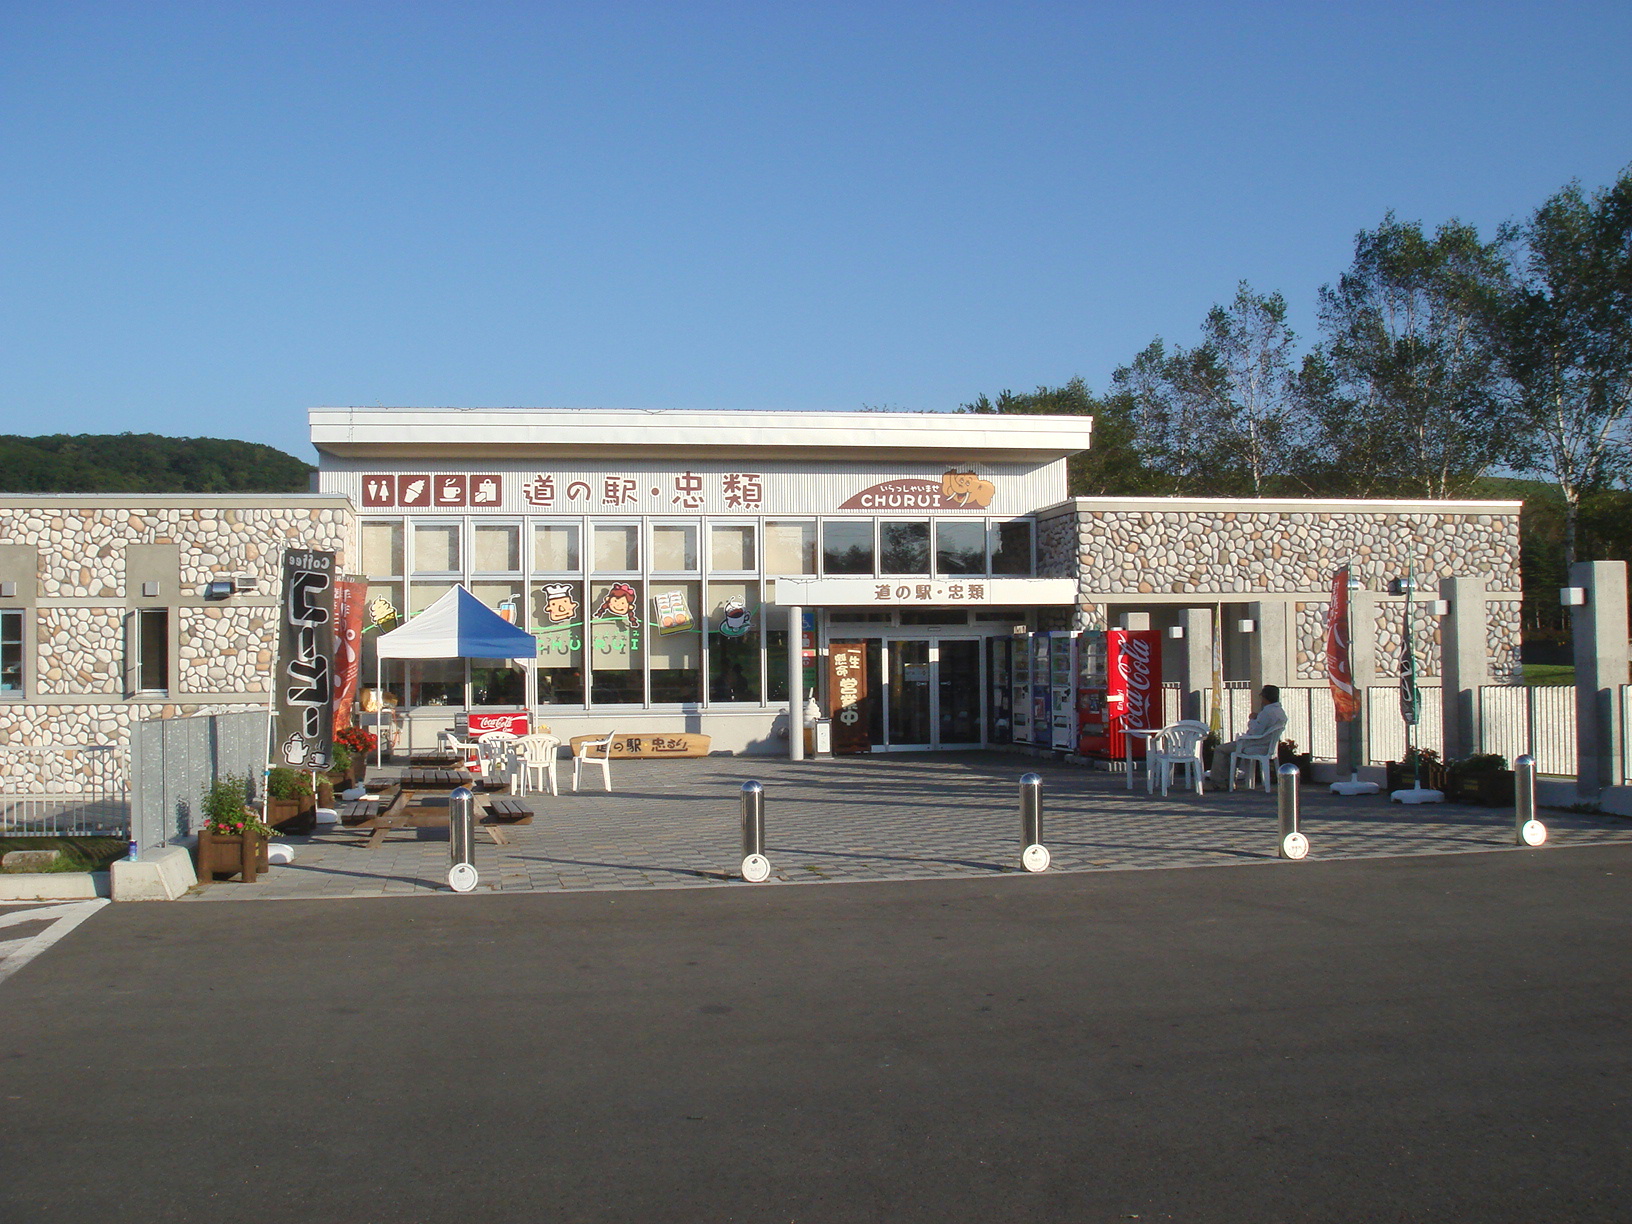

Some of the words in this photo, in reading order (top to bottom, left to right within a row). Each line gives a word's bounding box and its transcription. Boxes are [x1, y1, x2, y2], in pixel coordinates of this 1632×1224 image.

[524, 471, 763, 511] 道の駅・忠類
[880, 484, 940, 493] いらっしゃいませ
[861, 494, 941, 507] CHURUI
[874, 584, 985, 601] 道の駅・忠類
[847, 649, 861, 669] 一生
[839, 677, 859, 726] 営業中
[480, 716, 513, 728] Coca-Cola
